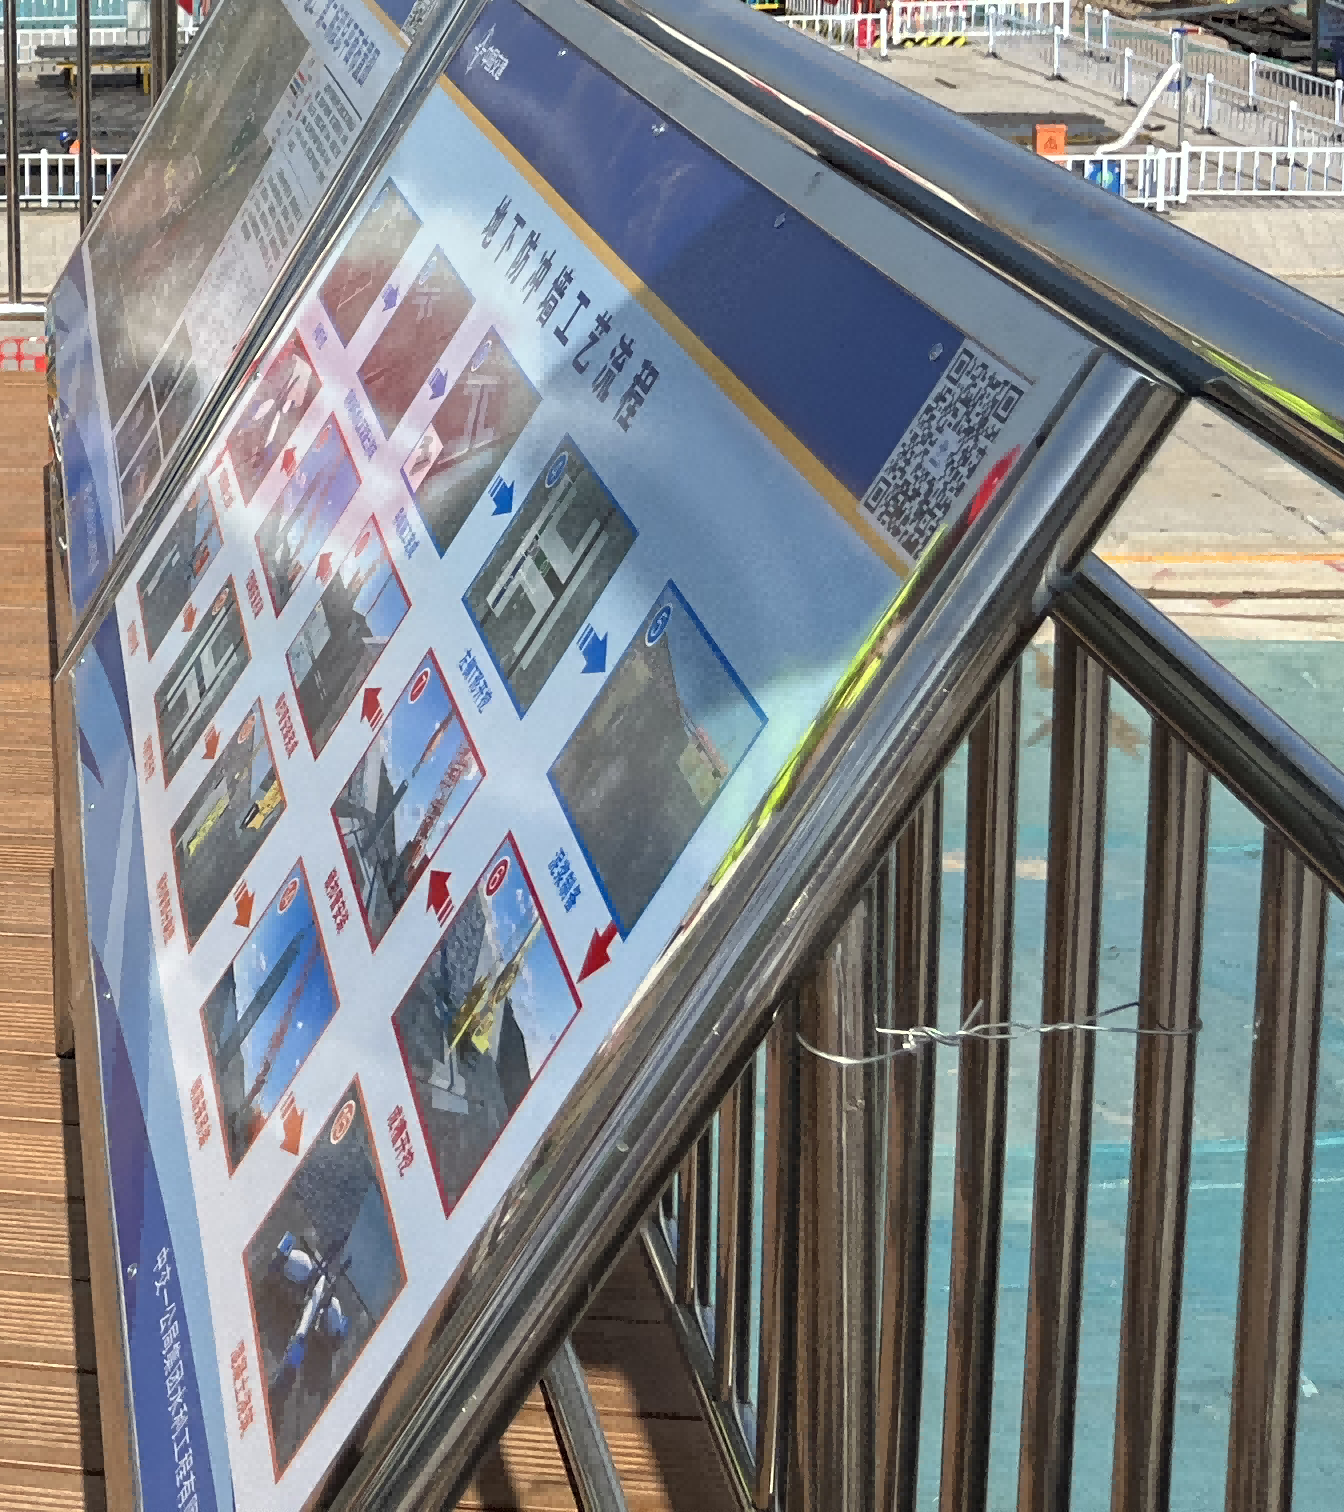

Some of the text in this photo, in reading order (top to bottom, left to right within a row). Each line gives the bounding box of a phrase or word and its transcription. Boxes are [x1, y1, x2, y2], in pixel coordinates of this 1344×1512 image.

[480, 195, 661, 433] 地下防冲墙工艺流程
[547, 847, 581, 913] 泥浆制备
[386, 1102, 414, 1178] 成槽开挖
